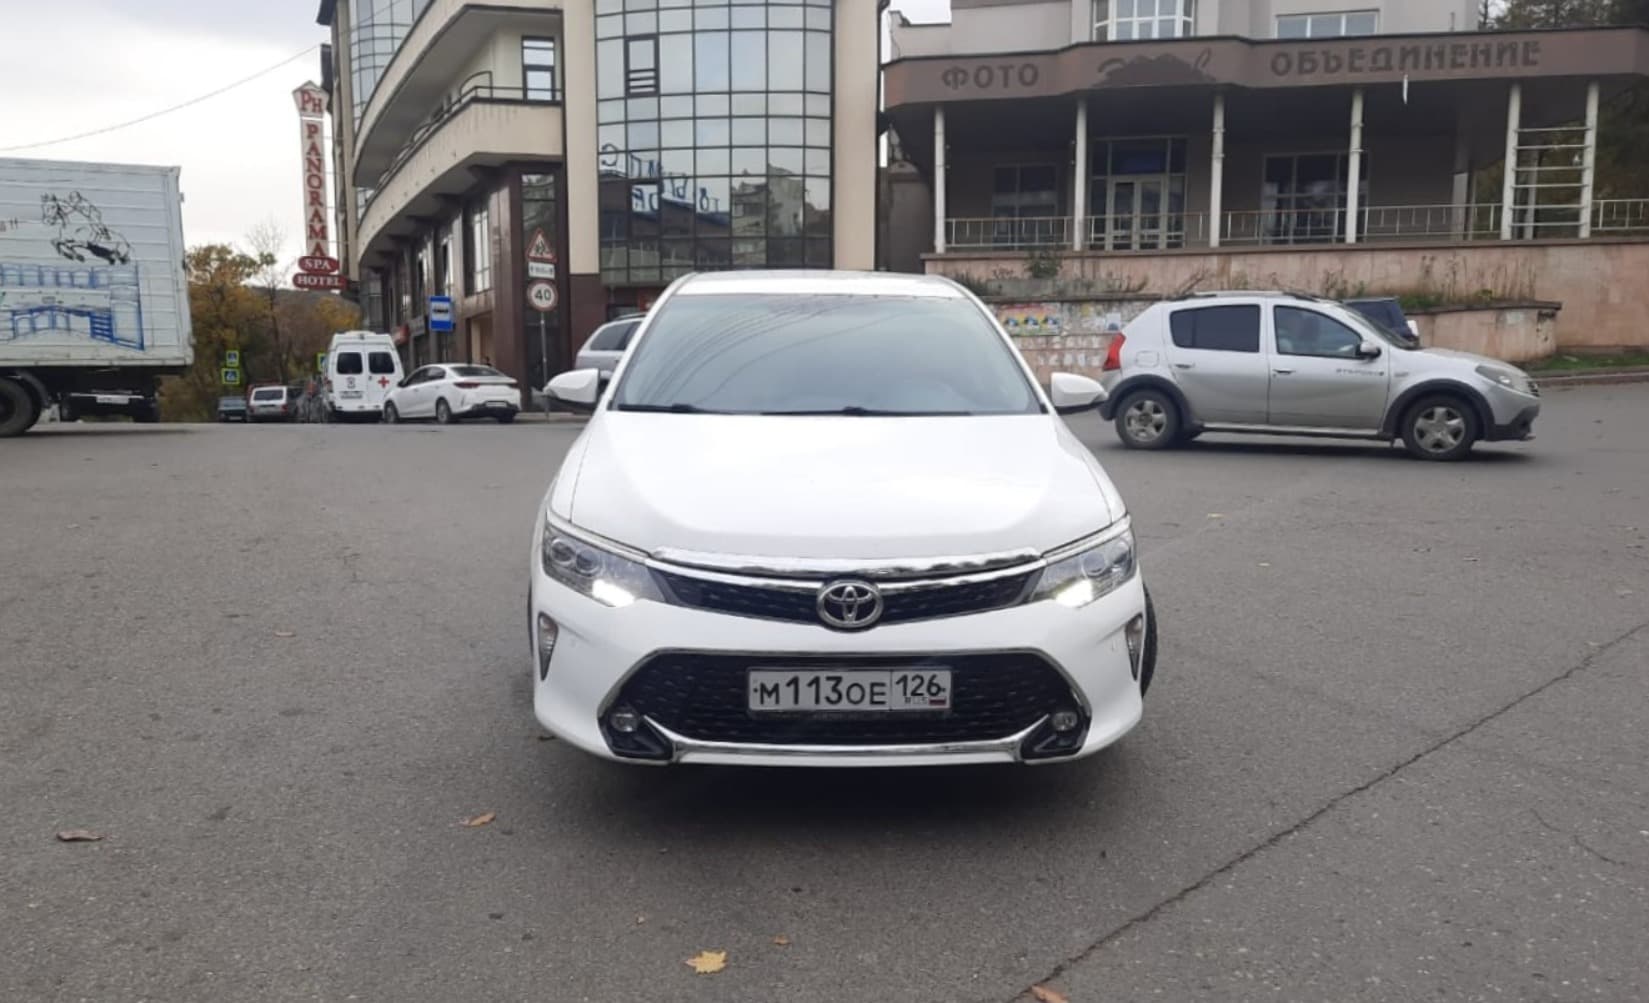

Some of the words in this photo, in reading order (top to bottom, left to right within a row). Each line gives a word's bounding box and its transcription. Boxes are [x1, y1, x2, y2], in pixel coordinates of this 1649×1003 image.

[1270, 40, 1542, 77] ОБЪЕДИНЕНИЕ
[942, 63, 1039, 90] ФОТО
[300, 88, 323, 113] PH
[306, 123, 329, 257] PANORAMA
[303, 257, 333, 271] SPA
[297, 274, 343, 287] HOTEL
[534, 288, 552, 301] 40
[895, 673, 942, 697] 126
